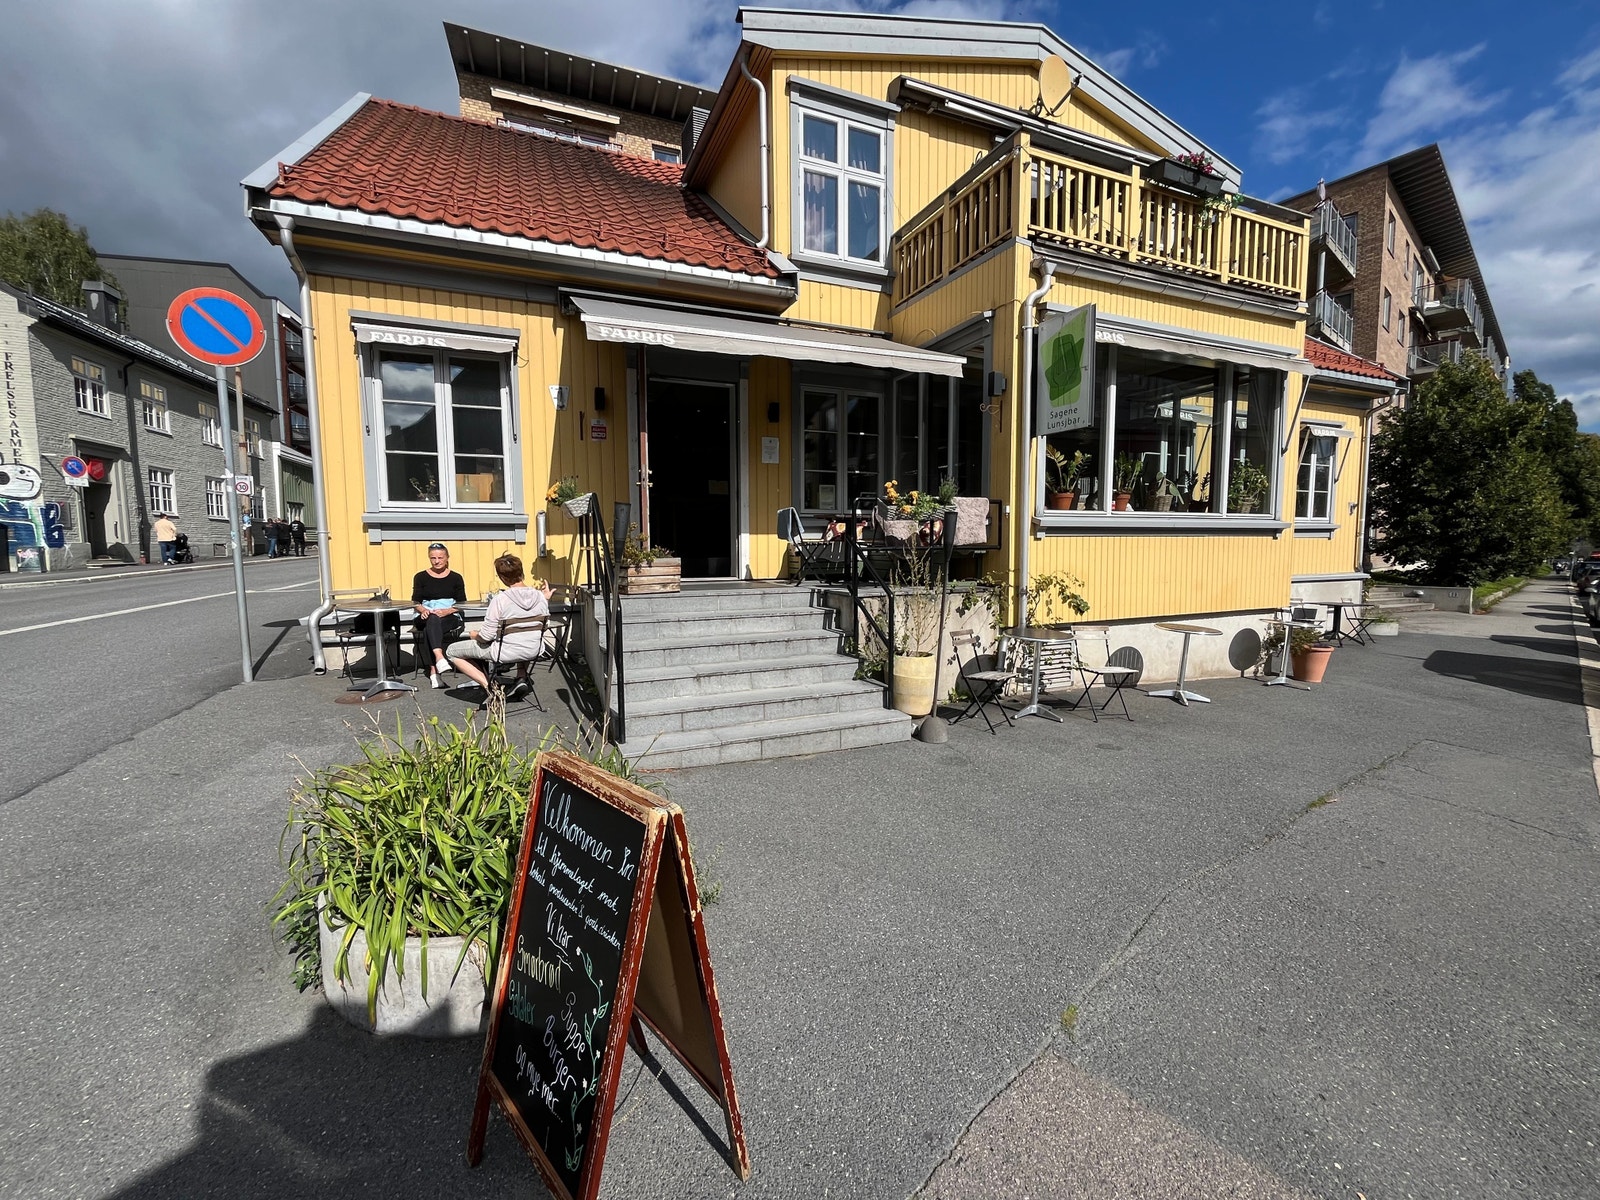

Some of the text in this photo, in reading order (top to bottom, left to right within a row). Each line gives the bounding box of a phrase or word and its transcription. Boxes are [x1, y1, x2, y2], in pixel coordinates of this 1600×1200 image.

[369, 331, 447, 347] FARRIS
[598, 326, 676, 345] FARRIS
[1095, 330, 1126, 345] RRIS
[1050, 407, 1079, 419] Sagene
[1047, 417, 1081, 430] Lunsjbar
[534, 831, 549, 858] til
[545, 901, 573, 949] Vi har
[560, 991, 586, 1062] Suppe
[543, 1014, 577, 1092] Burger
